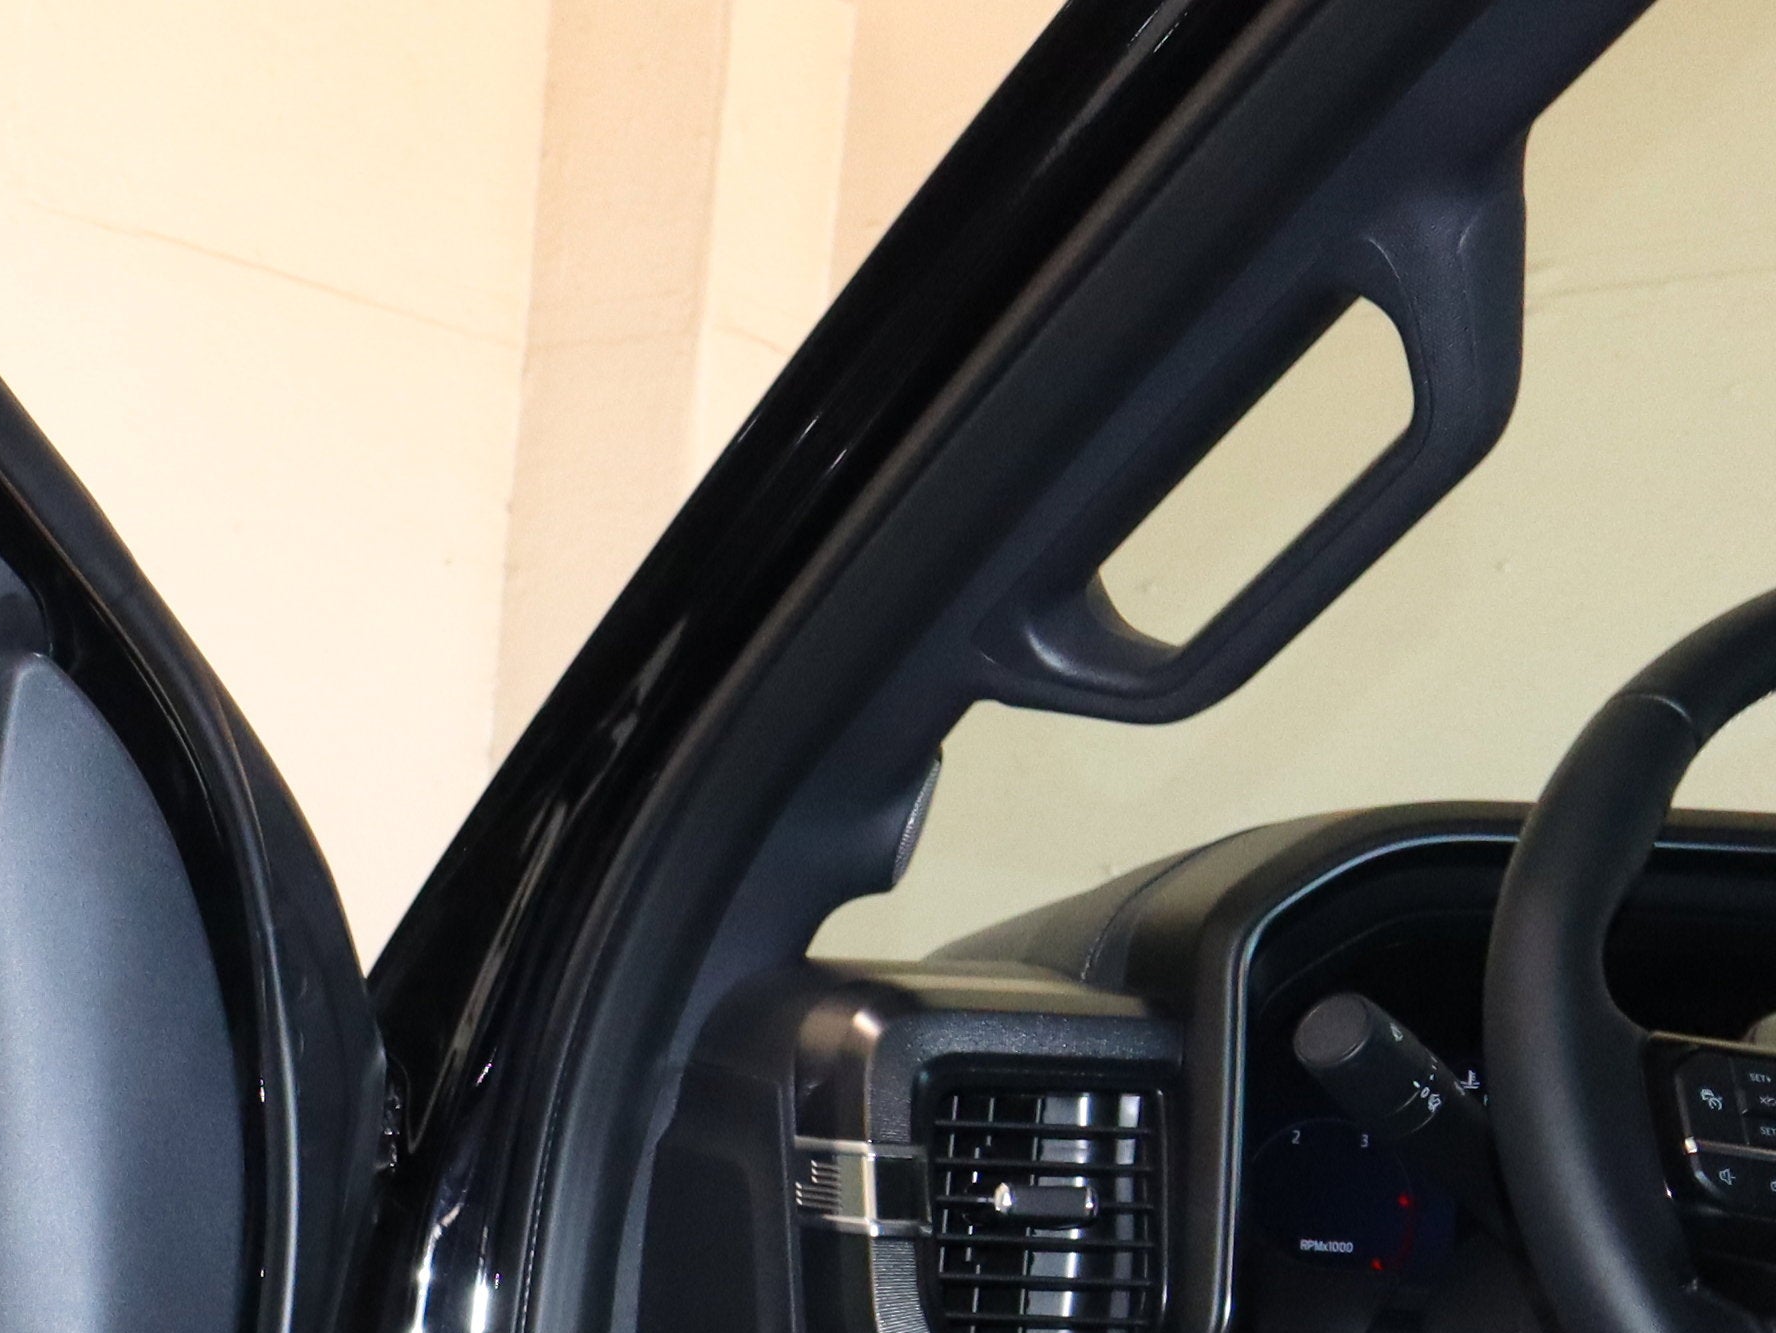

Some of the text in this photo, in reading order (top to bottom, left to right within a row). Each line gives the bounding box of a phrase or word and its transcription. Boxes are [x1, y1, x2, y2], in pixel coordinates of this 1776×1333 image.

[1291, 1130, 1300, 1144] 2
[1361, 1134, 1369, 1148] 3
[1300, 1239, 1353, 1253] RPMx1000
